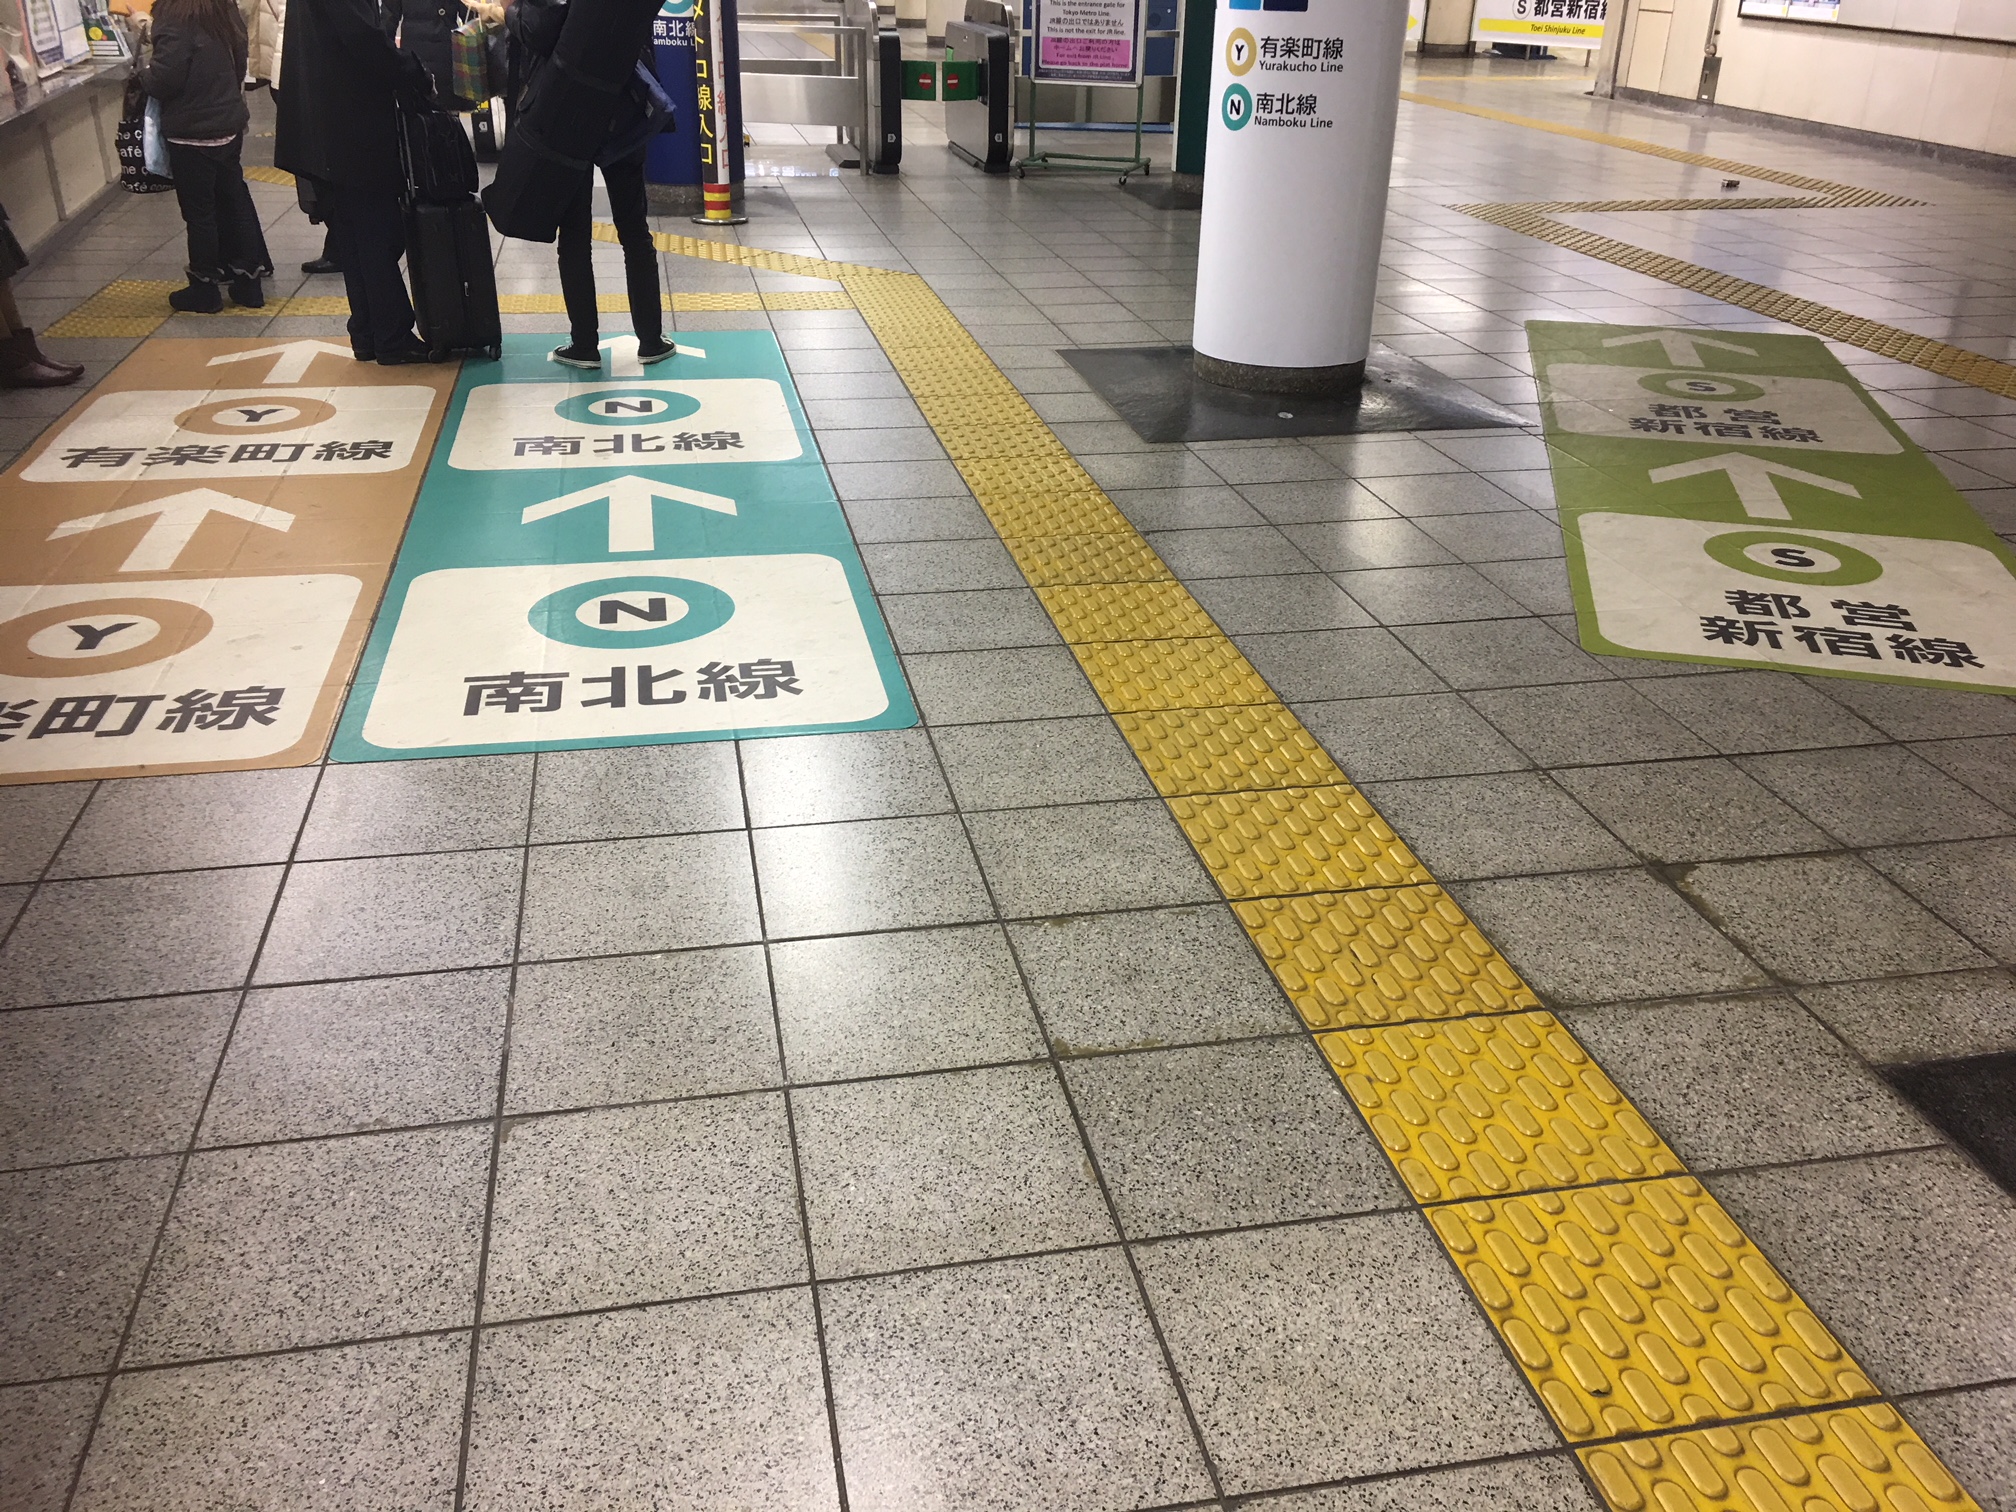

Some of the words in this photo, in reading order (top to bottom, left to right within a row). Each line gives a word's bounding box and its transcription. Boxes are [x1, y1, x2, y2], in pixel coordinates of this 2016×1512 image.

[1063, 9, 1079, 17] Tokyo
[1517, 0, 1526, 14] S
[1530, 24, 1543, 32] Toei
[1544, 24, 1571, 34] Shinjuku
[1571, 26, 1586, 34] Line
[651, 37, 687, 46] amboku
[1260, 36, 1344, 60] 有楽町線
[1235, 44, 1245, 61] Y
[1259, 60, 1317, 72] Yurakucho
[1320, 62, 1344, 72] Line
[1229, 99, 1241, 115] N
[1256, 92, 1317, 116] 南北線
[1254, 115, 1306, 128] Namboku
[1310, 118, 1333, 128] Line
[1686, 381, 1717, 392] S
[238, 408, 284, 423] Y
[604, 400, 653, 413] N
[1648, 403, 1782, 425] 都営
[1628, 417, 1824, 443] 新宿線
[512, 430, 746, 456] 南北線
[62, 440, 394, 468] 有楽町線
[1771, 548, 1815, 567] S
[599, 598, 667, 624] N
[1724, 590, 1918, 632] 都営
[67, 621, 139, 650] Y
[1700, 616, 1986, 669] 新宿線
[463, 658, 804, 716] 南北線
